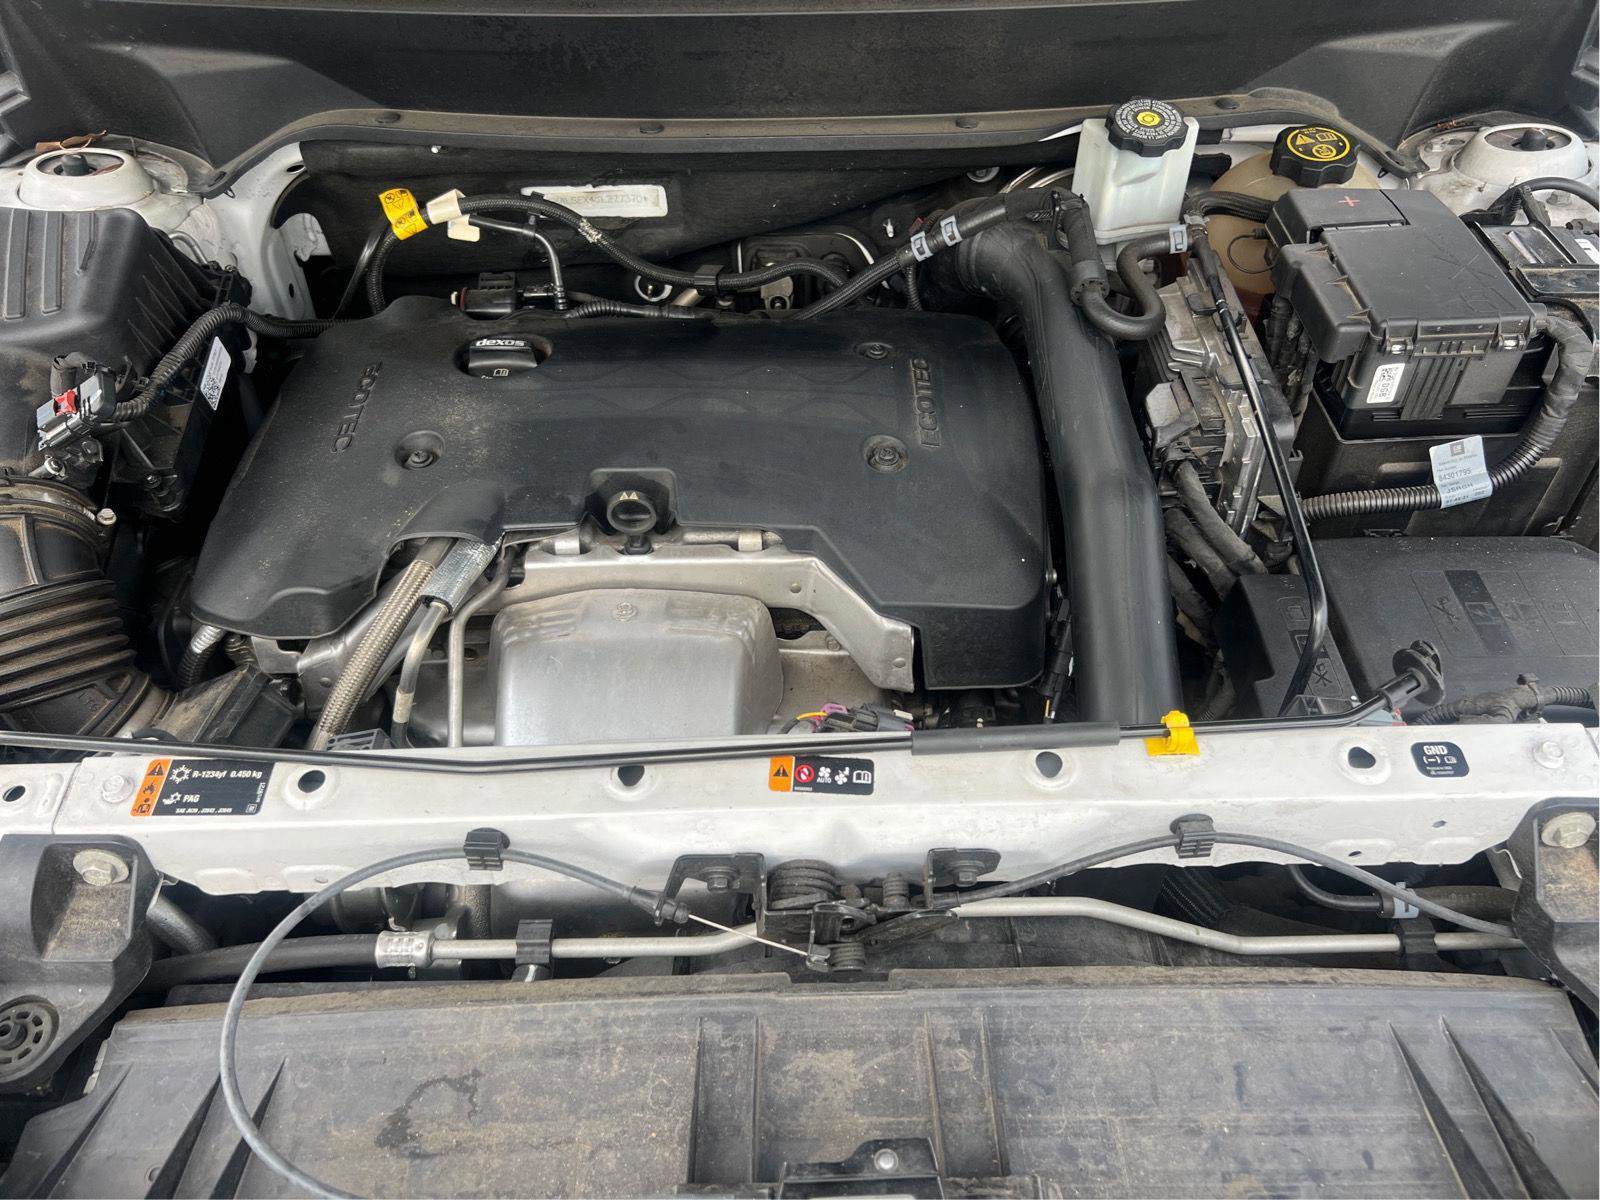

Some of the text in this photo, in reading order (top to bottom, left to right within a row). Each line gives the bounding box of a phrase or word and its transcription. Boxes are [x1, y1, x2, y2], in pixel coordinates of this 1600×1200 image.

[475, 338, 526, 347] dexos
[332, 361, 383, 453] ECOTEC
[909, 356, 941, 448] ECOTEC
[1423, 745, 1448, 755] GND
[192, 770, 263, 779] R-1234yf 0.450 kg
[182, 793, 201, 803] PAG
